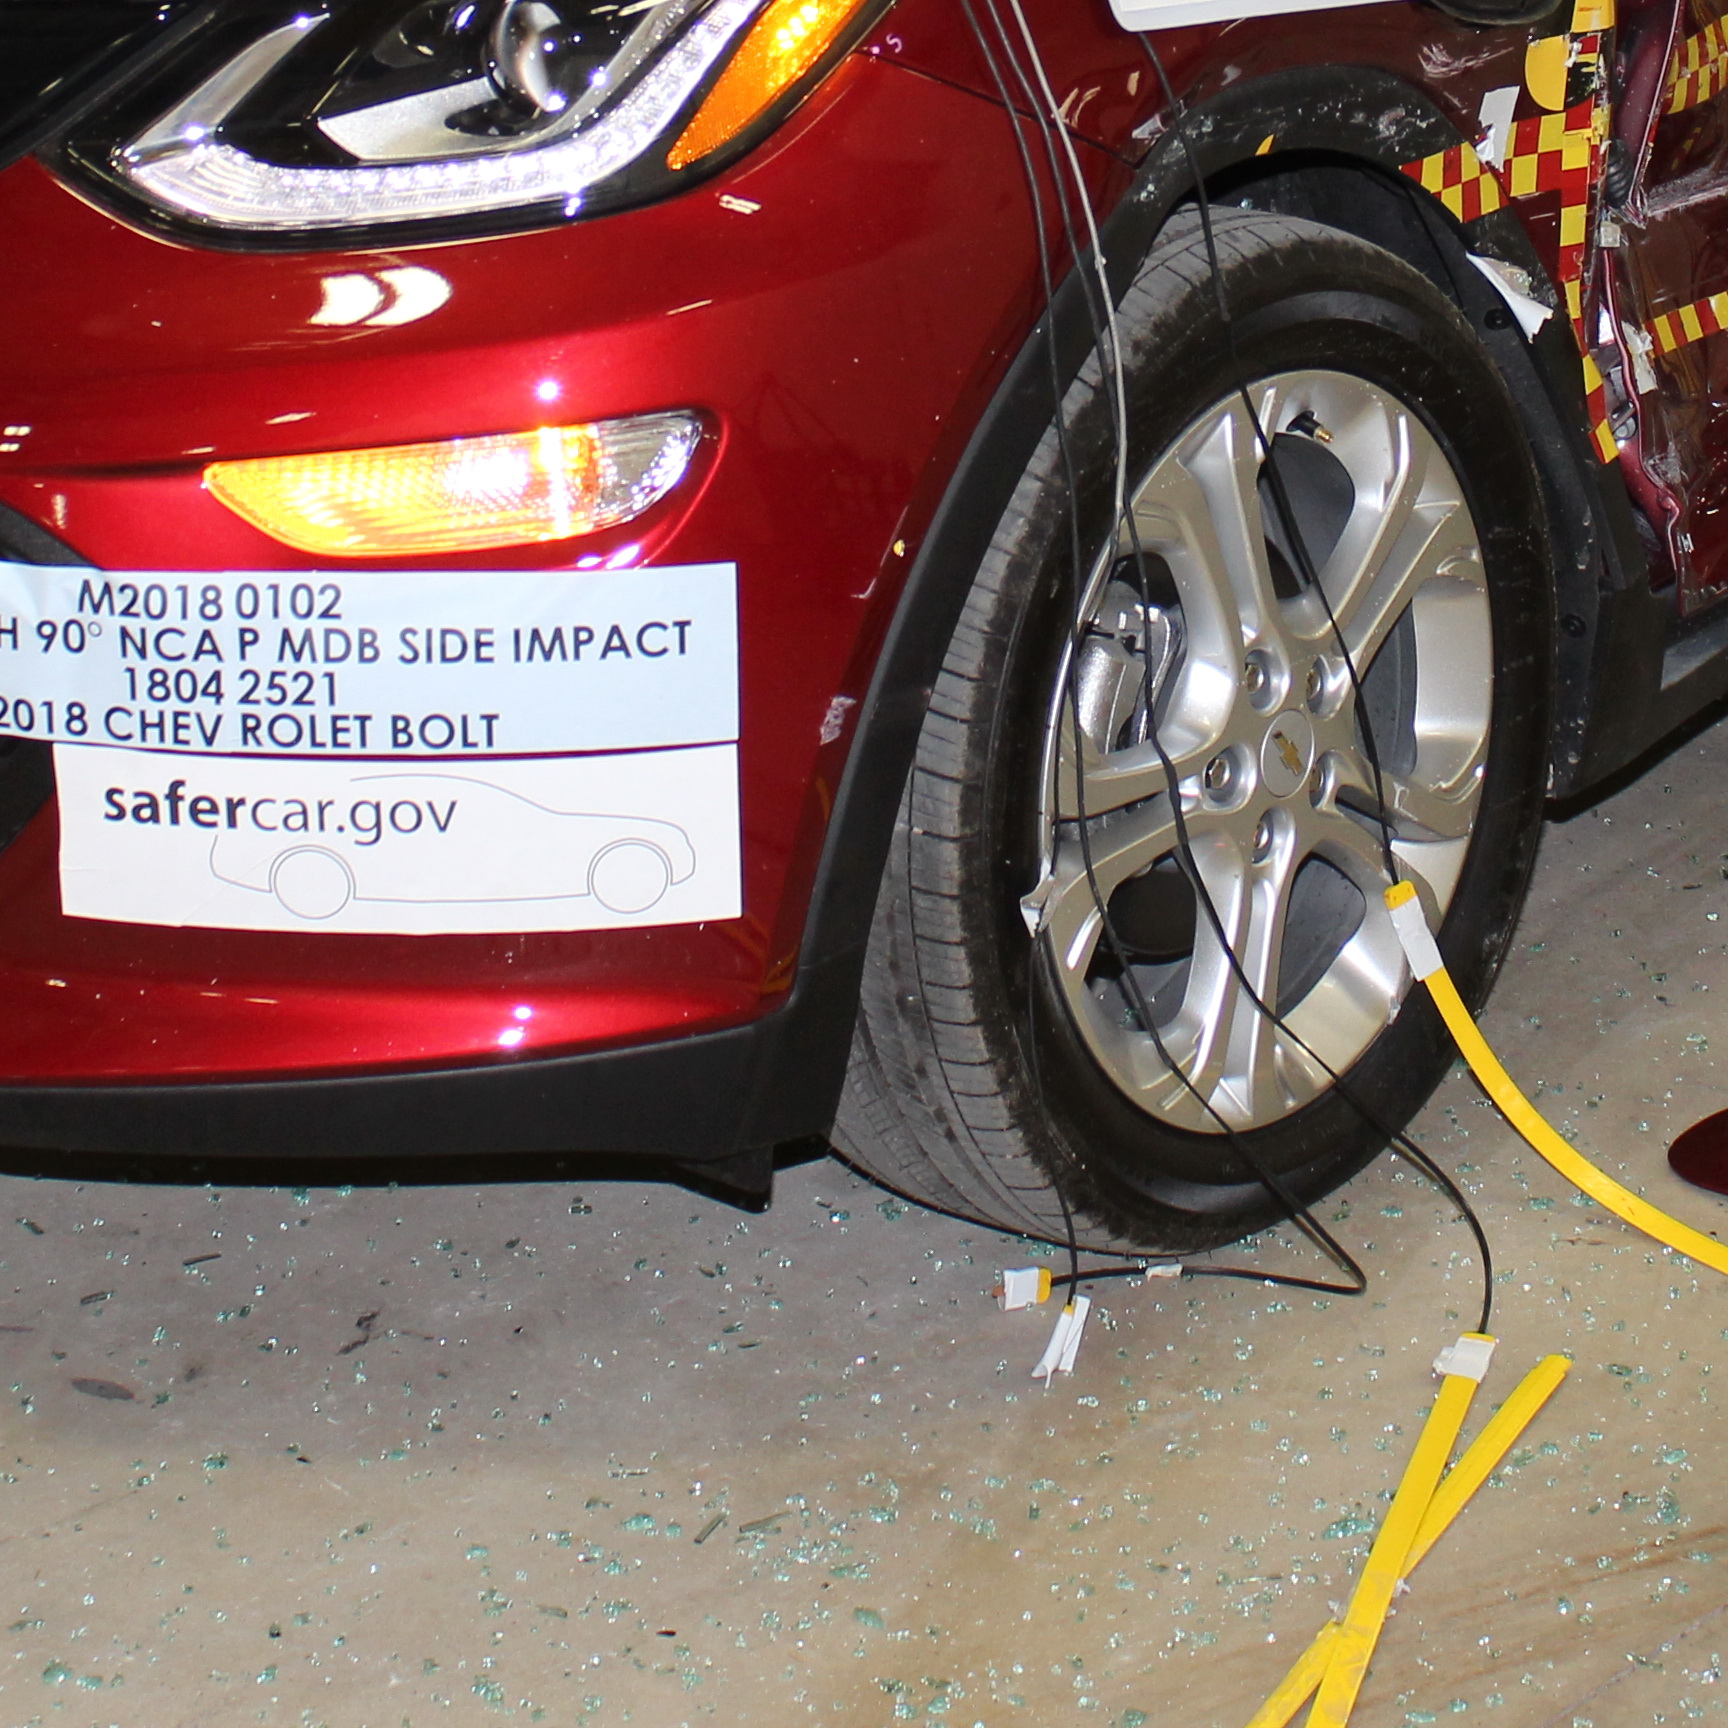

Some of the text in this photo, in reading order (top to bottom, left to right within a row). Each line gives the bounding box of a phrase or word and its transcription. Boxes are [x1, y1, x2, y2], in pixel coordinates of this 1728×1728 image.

[35, 617, 103, 654] 90°
[277, 627, 382, 665] MDB
[398, 627, 496, 665] SIDE
[510, 619, 693, 662] IMPACT
[389, 712, 501, 750] BOLT
[103, 780, 459, 847] safercar.gov
